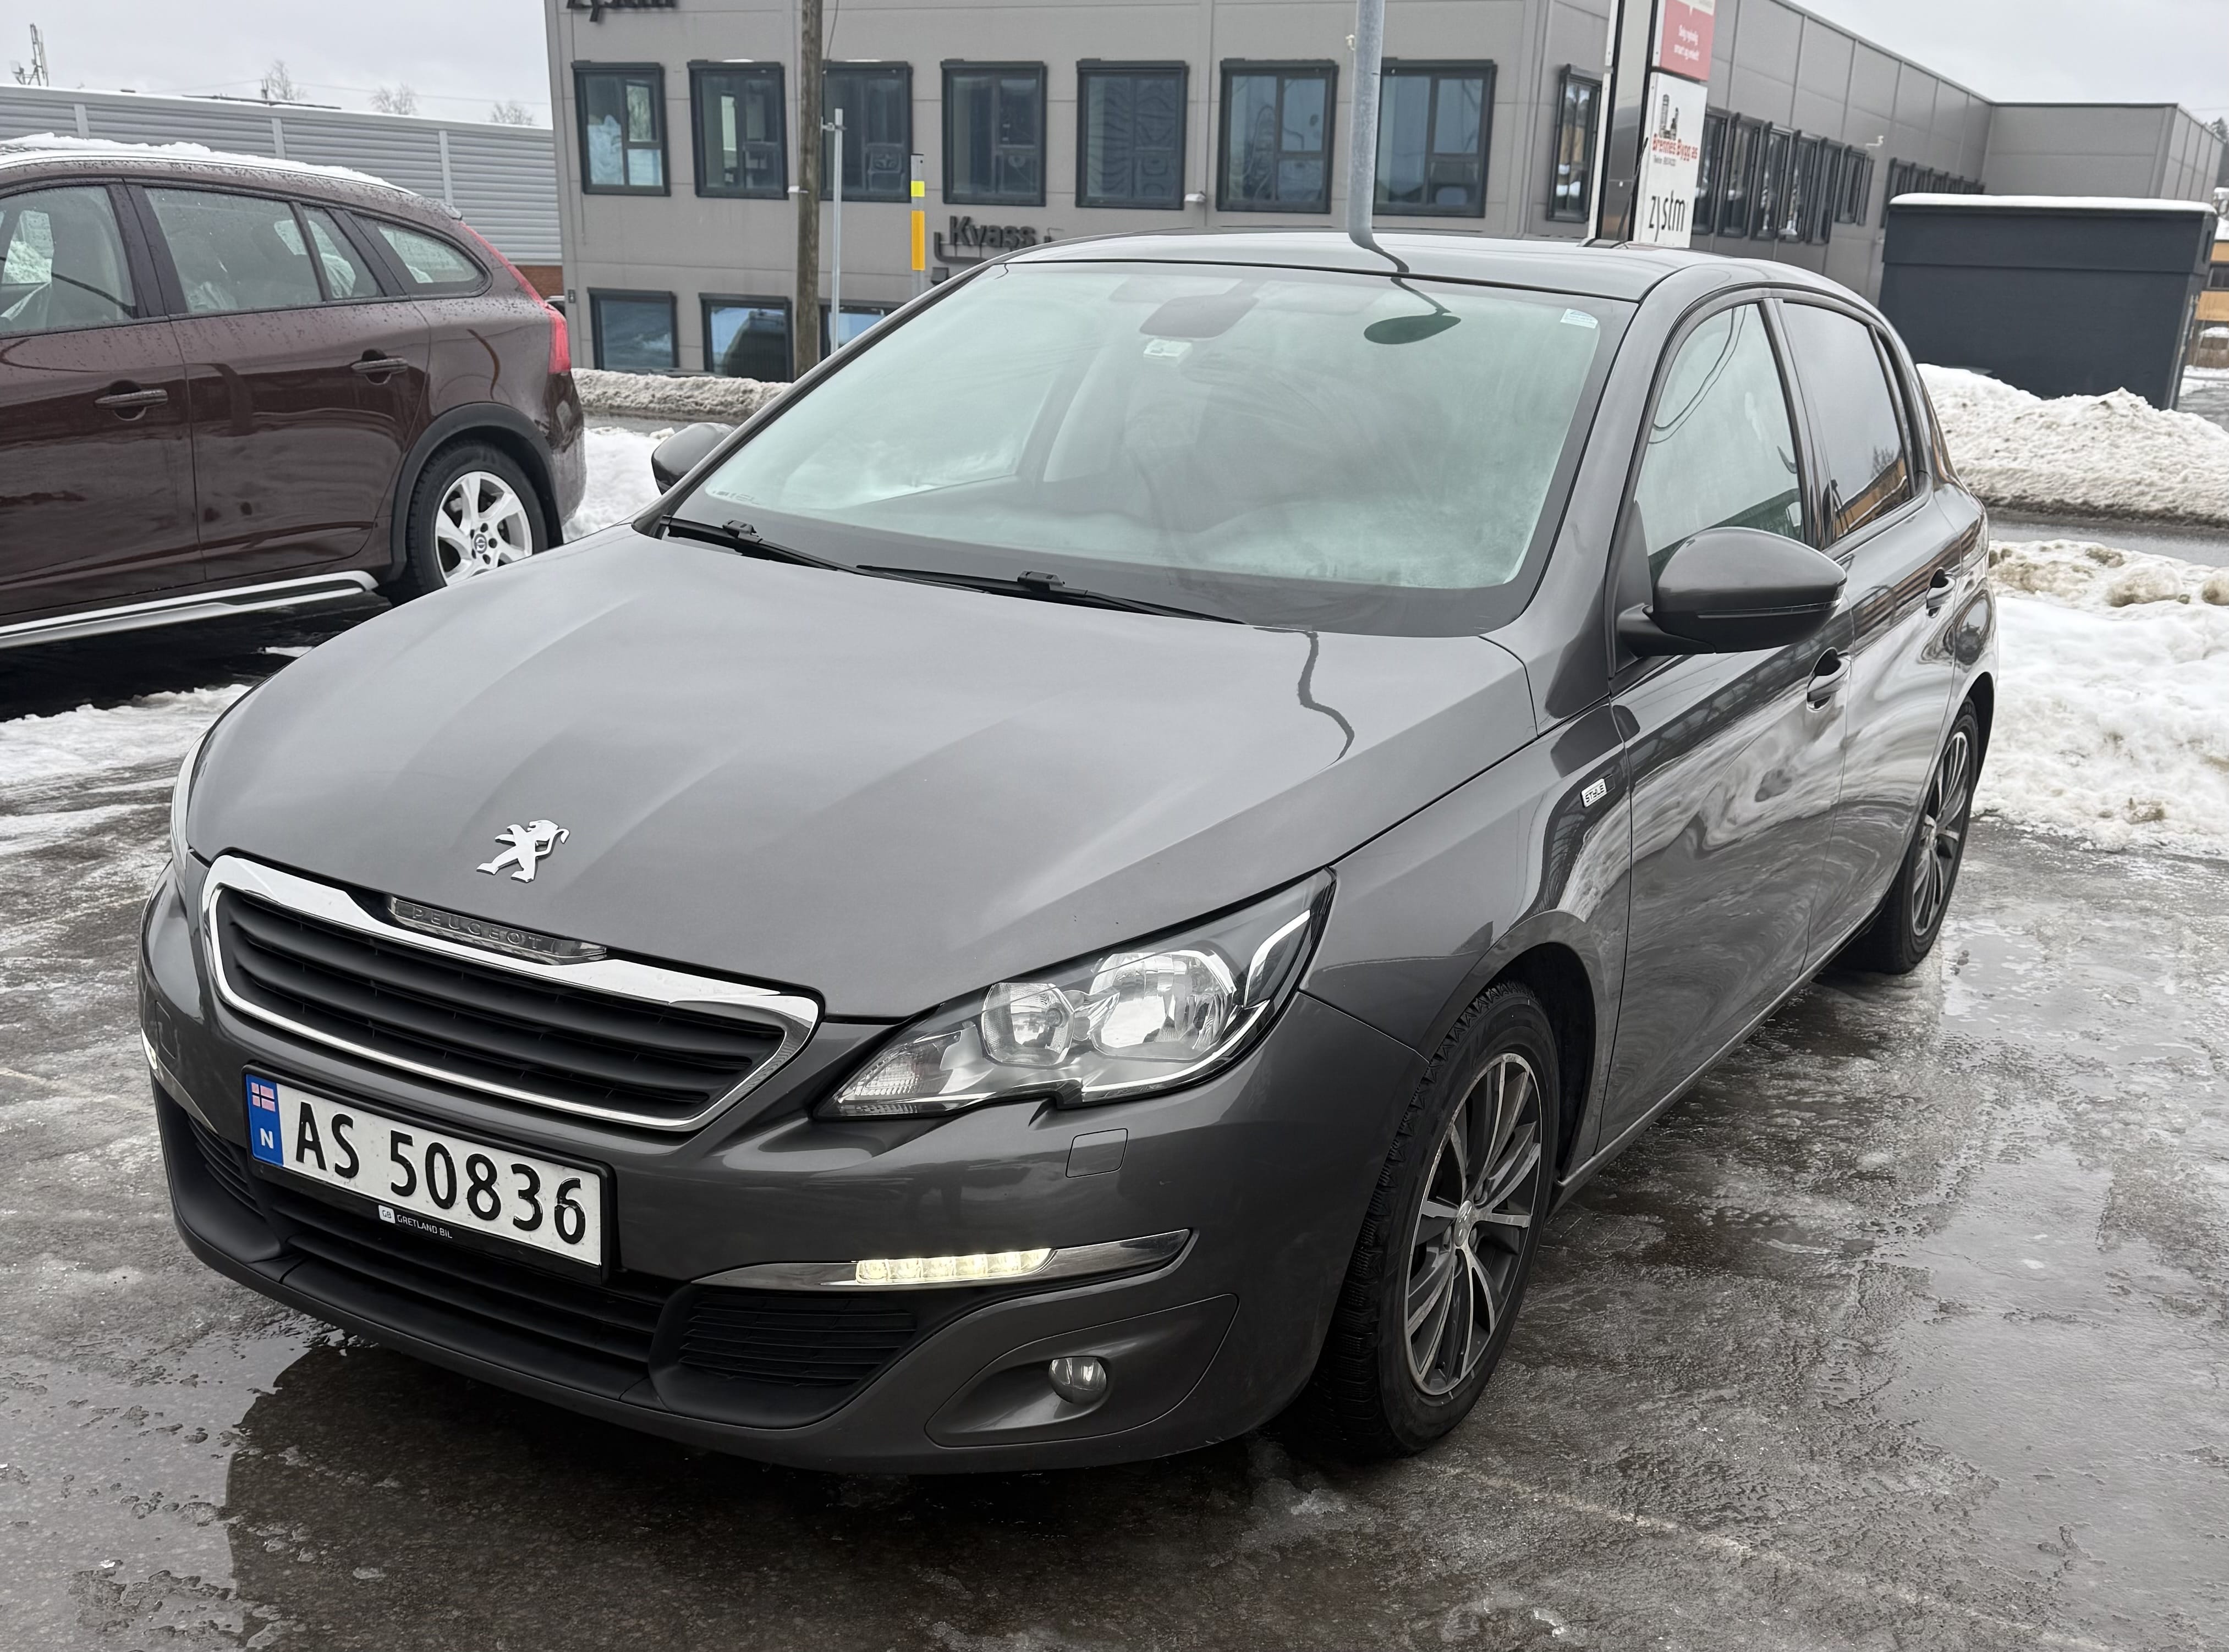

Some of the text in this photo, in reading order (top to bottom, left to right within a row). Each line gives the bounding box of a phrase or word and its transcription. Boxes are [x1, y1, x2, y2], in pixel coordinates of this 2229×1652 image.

[1649, 189, 1685, 242] zystm
[949, 216, 1036, 248] Kvass
[1585, 784, 1605, 803] STYLE
[412, 905, 542, 949] PEUGEOT
[260, 1127, 274, 1149] N
[296, 1101, 586, 1244] AS 50836
[382, 1210, 453, 1239] GB GRETLAND BIL
